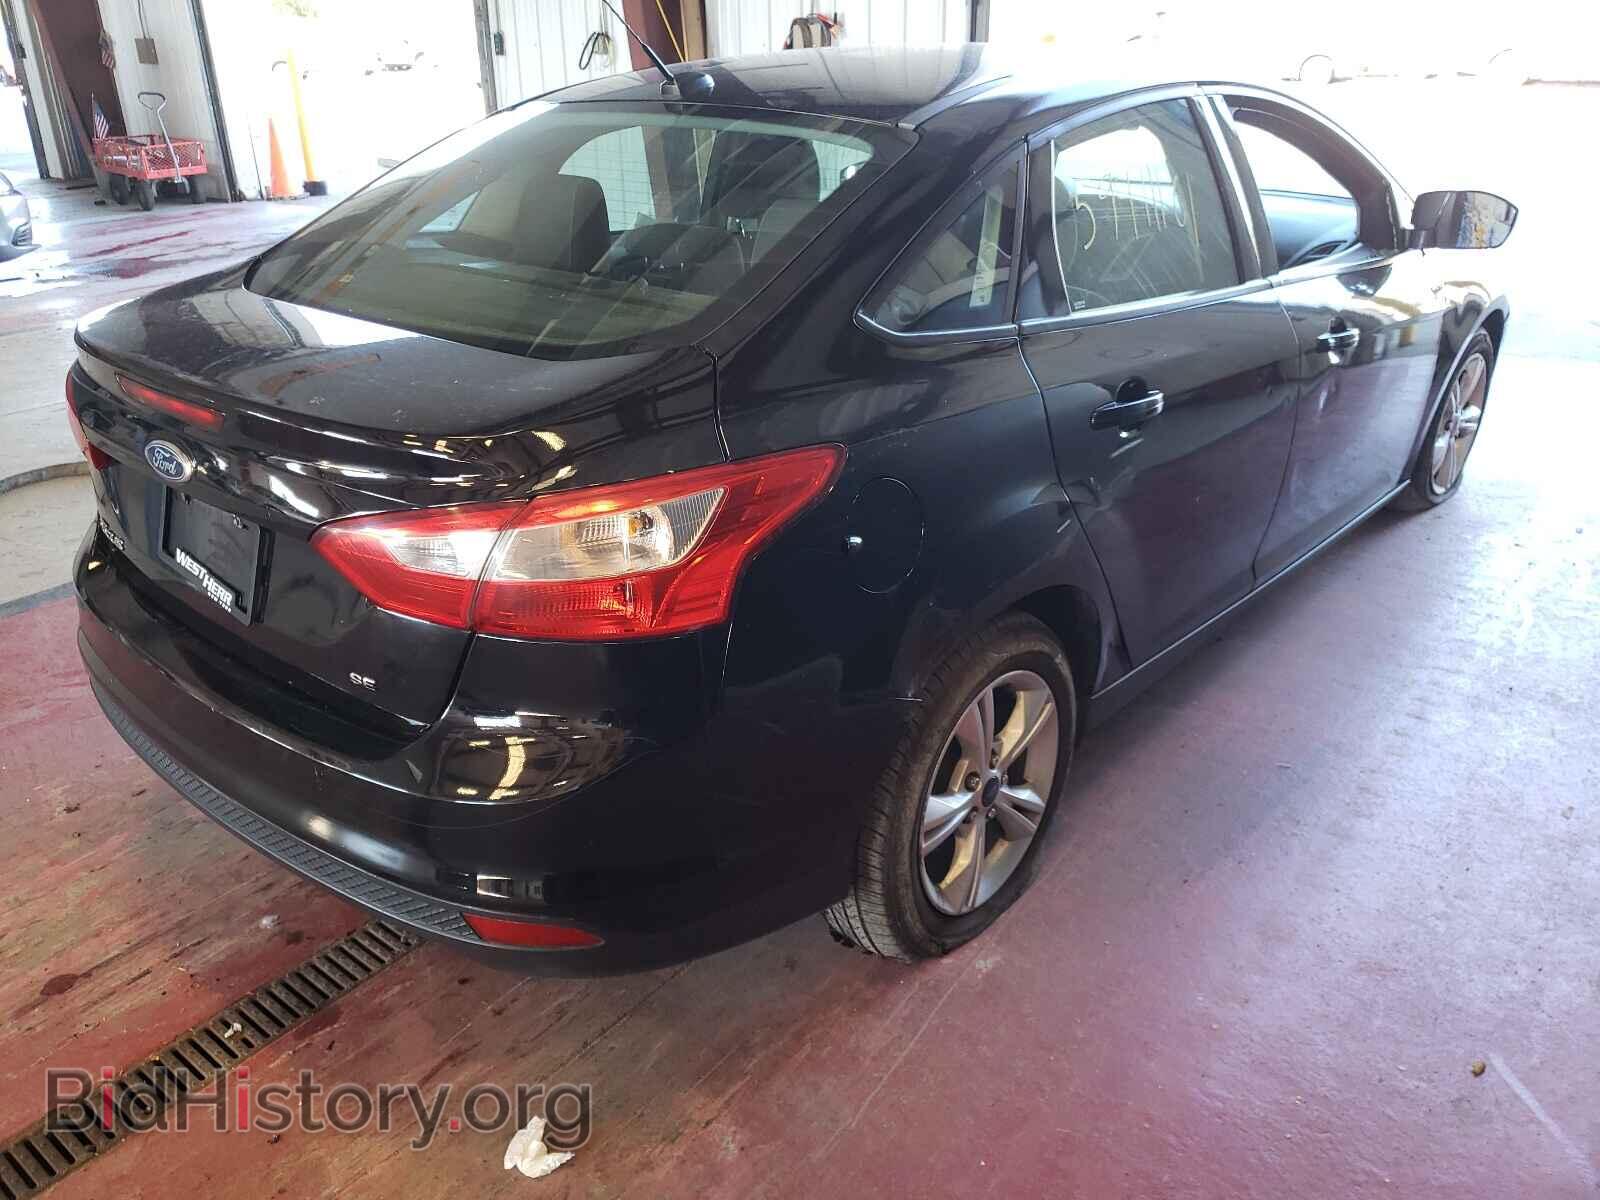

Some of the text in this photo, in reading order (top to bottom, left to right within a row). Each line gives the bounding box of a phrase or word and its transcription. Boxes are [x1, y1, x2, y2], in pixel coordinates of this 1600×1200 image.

[153, 447, 177, 475] Ford
[176, 547, 207, 579] WEST
[202, 574, 232, 606] HERR
[350, 672, 376, 691] SE
